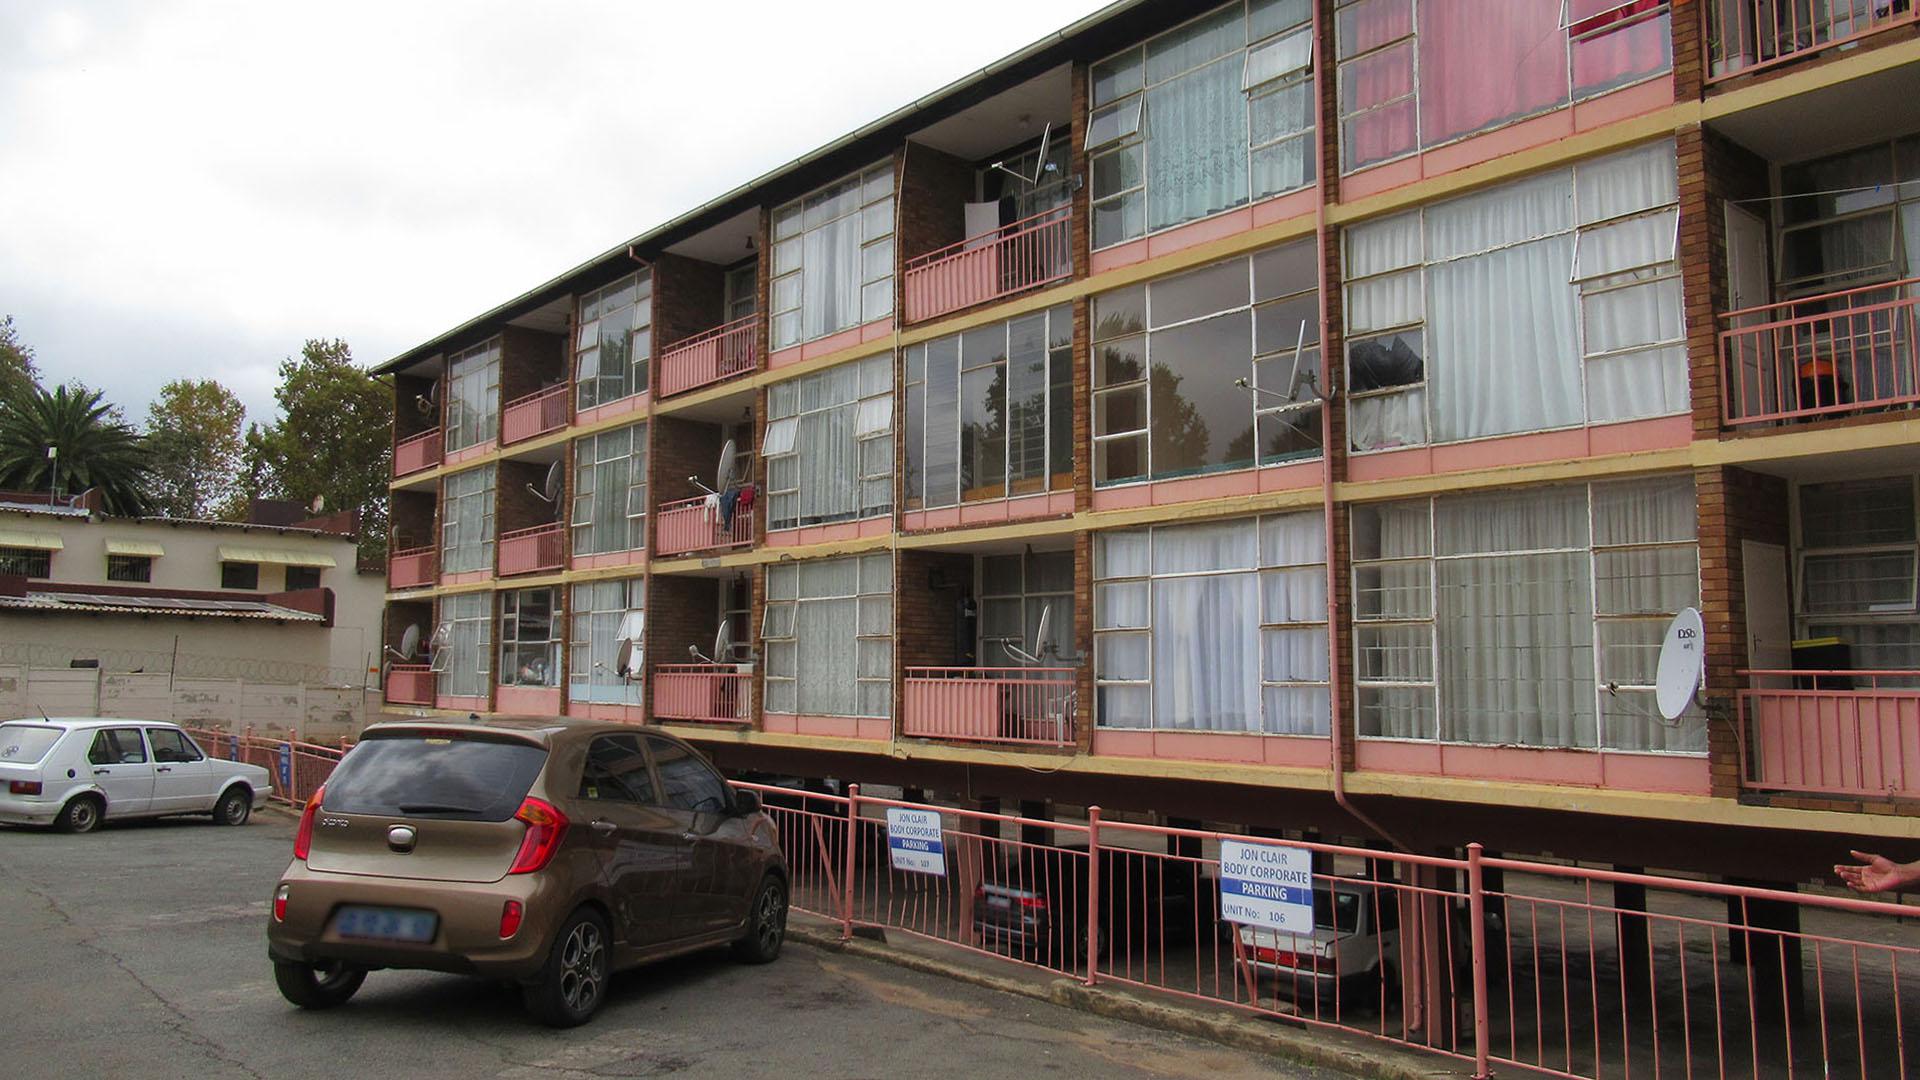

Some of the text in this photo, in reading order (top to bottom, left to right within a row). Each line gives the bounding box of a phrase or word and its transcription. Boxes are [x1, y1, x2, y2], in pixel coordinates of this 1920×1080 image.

[900, 813, 927, 824] JON CLAIR
[890, 824, 939, 838] BODY CORPORATE
[902, 839, 929, 851] PARKING
[1240, 848, 1288, 865] JON CLAIR
[1224, 861, 1308, 884] BODY CORPORATE
[1242, 882, 1288, 900] PARKING
[1223, 903, 1285, 923] UNIT No: 106
